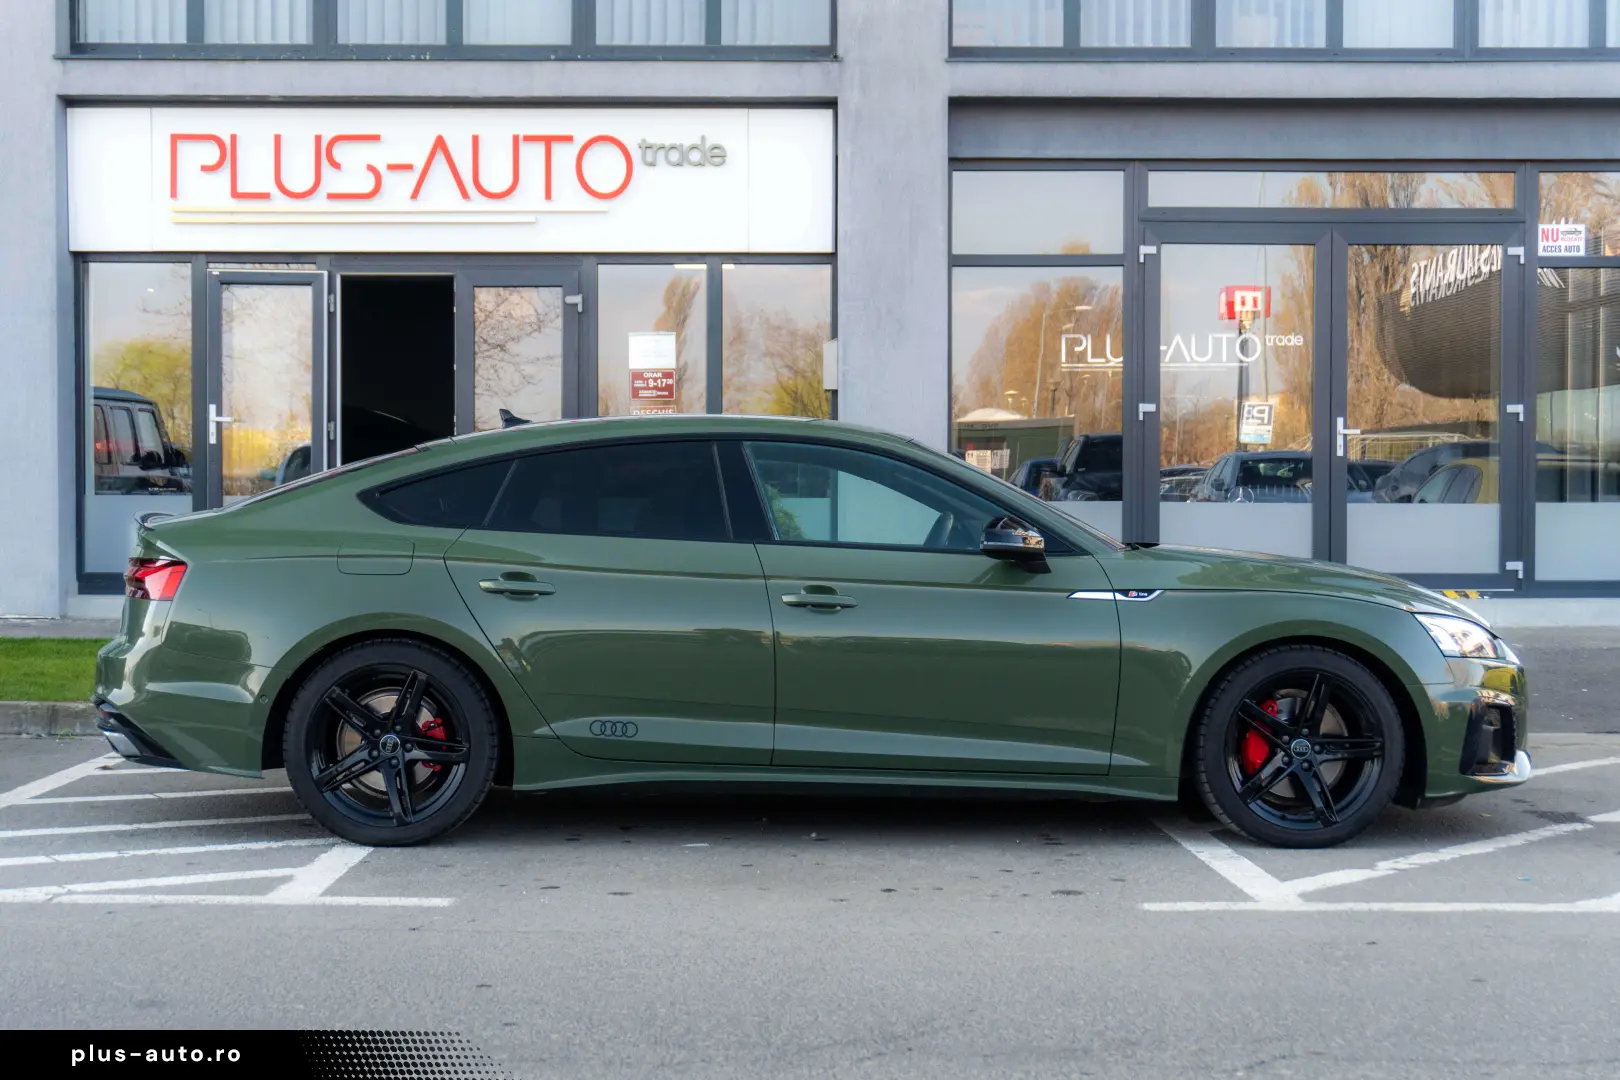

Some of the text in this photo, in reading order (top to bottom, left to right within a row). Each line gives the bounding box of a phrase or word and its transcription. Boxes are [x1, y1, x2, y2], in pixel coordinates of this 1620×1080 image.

[170, 133, 728, 201] PLUS-AUTO trade
[1541, 228, 1559, 242] NU
[1542, 245, 1580, 253] ACCES AUTO
[1061, 333, 1304, 363] PLU-AUTO trade
